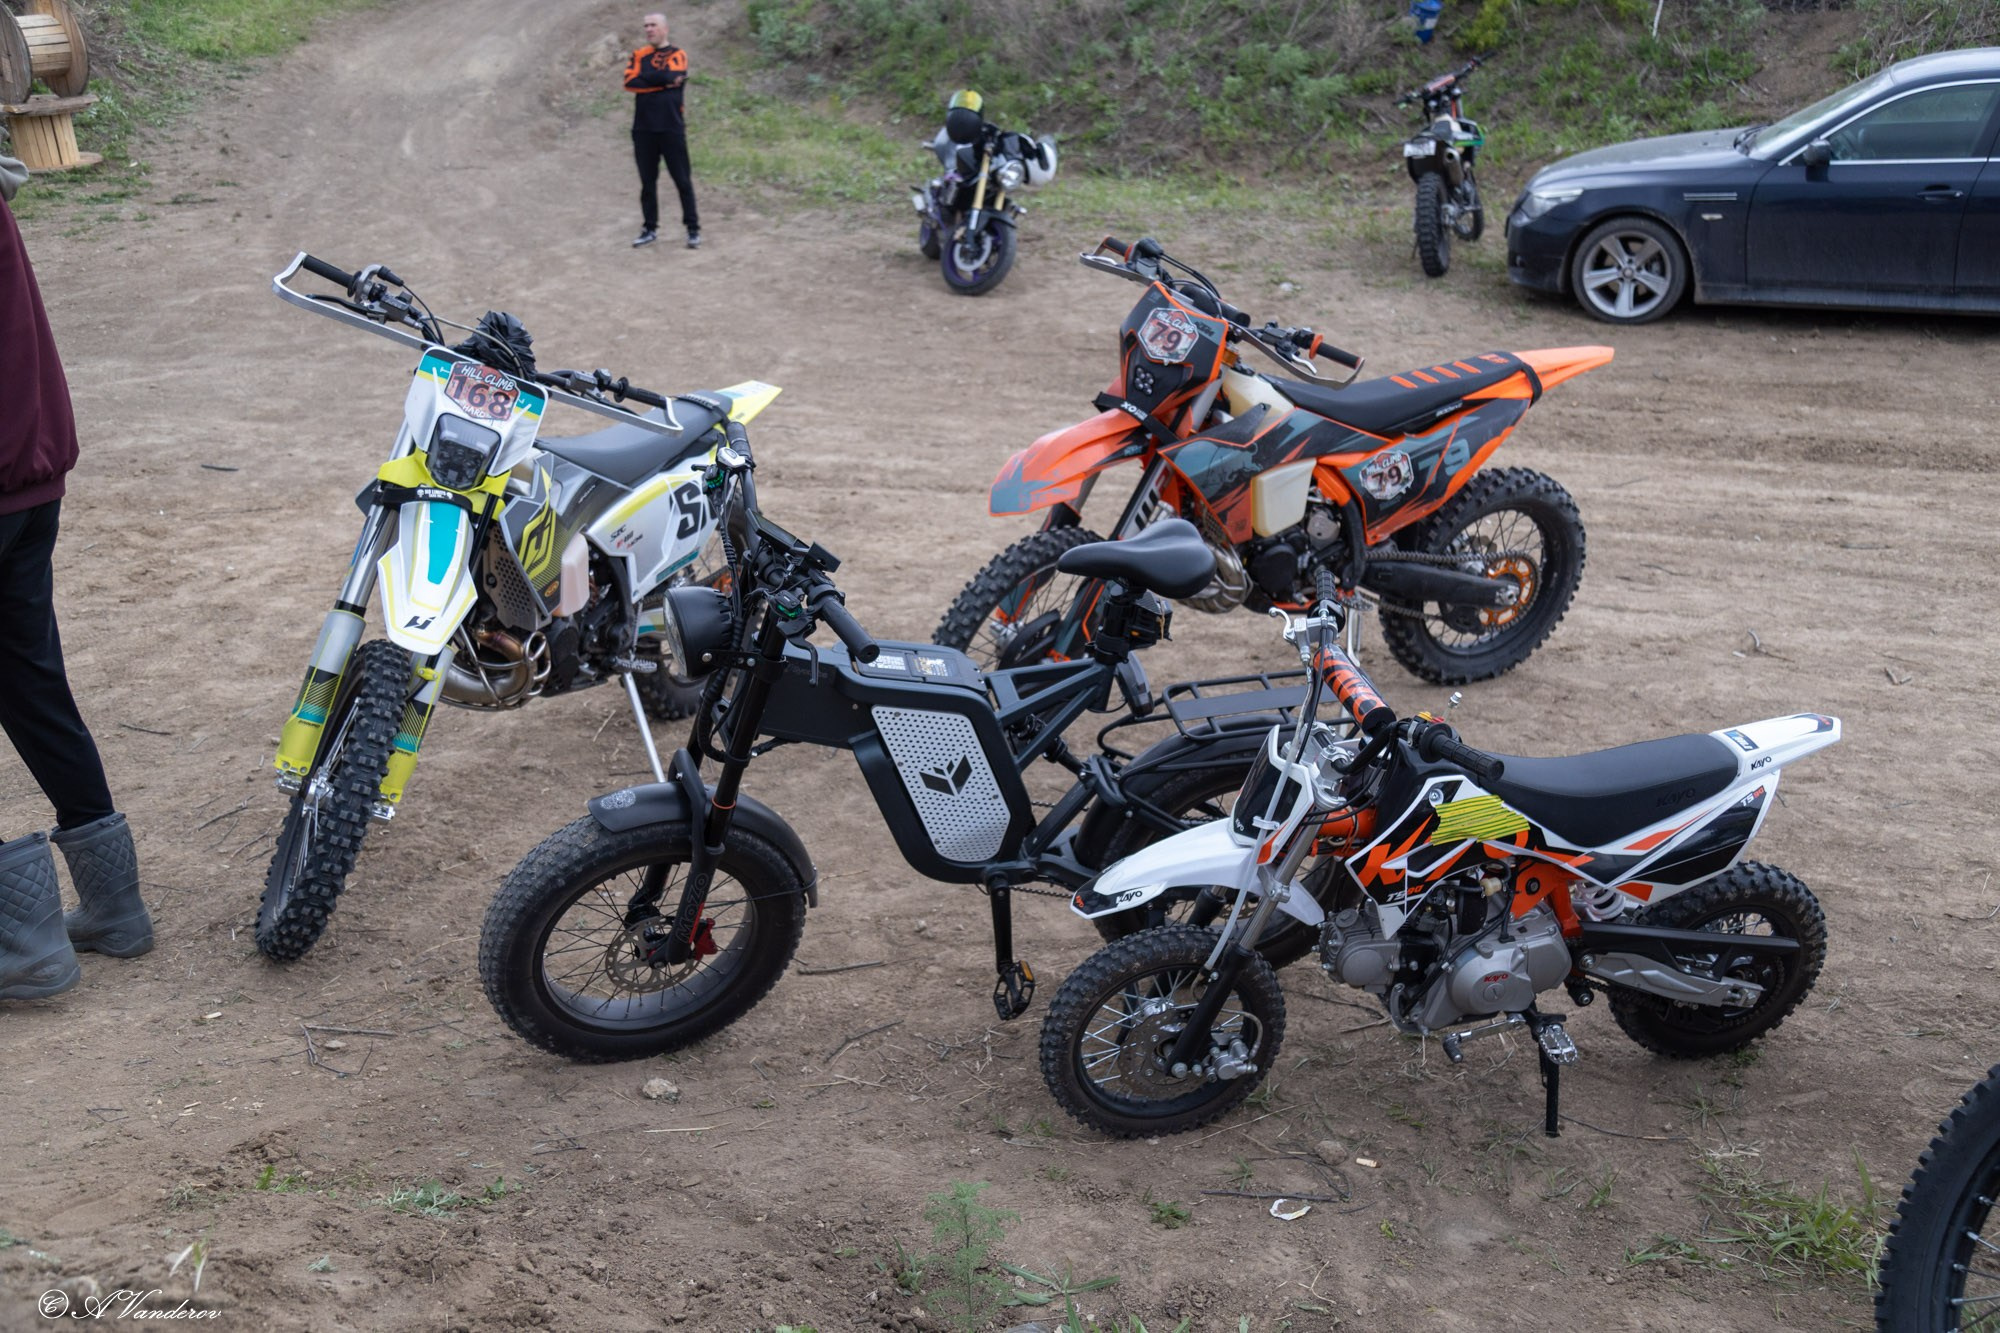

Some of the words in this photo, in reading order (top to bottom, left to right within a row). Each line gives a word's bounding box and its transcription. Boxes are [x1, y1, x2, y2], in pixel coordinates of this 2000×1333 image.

[1156, 311, 1171, 324] HILL
[1171, 318, 1196, 334] CLIMB
[1148, 321, 1182, 352] 79
[461, 364, 483, 380] HILL
[484, 374, 515, 391] CLIMB
[451, 375, 511, 418] 168
[462, 403, 486, 418] HARD
[1418, 438, 1471, 484] 79
[1371, 465, 1402, 493] 79
[1751, 756, 1772, 771] KAYO
[1740, 785, 1765, 807] TS90
[1115, 890, 1143, 904] KAYO
[1483, 973, 1509, 983] KAYO
